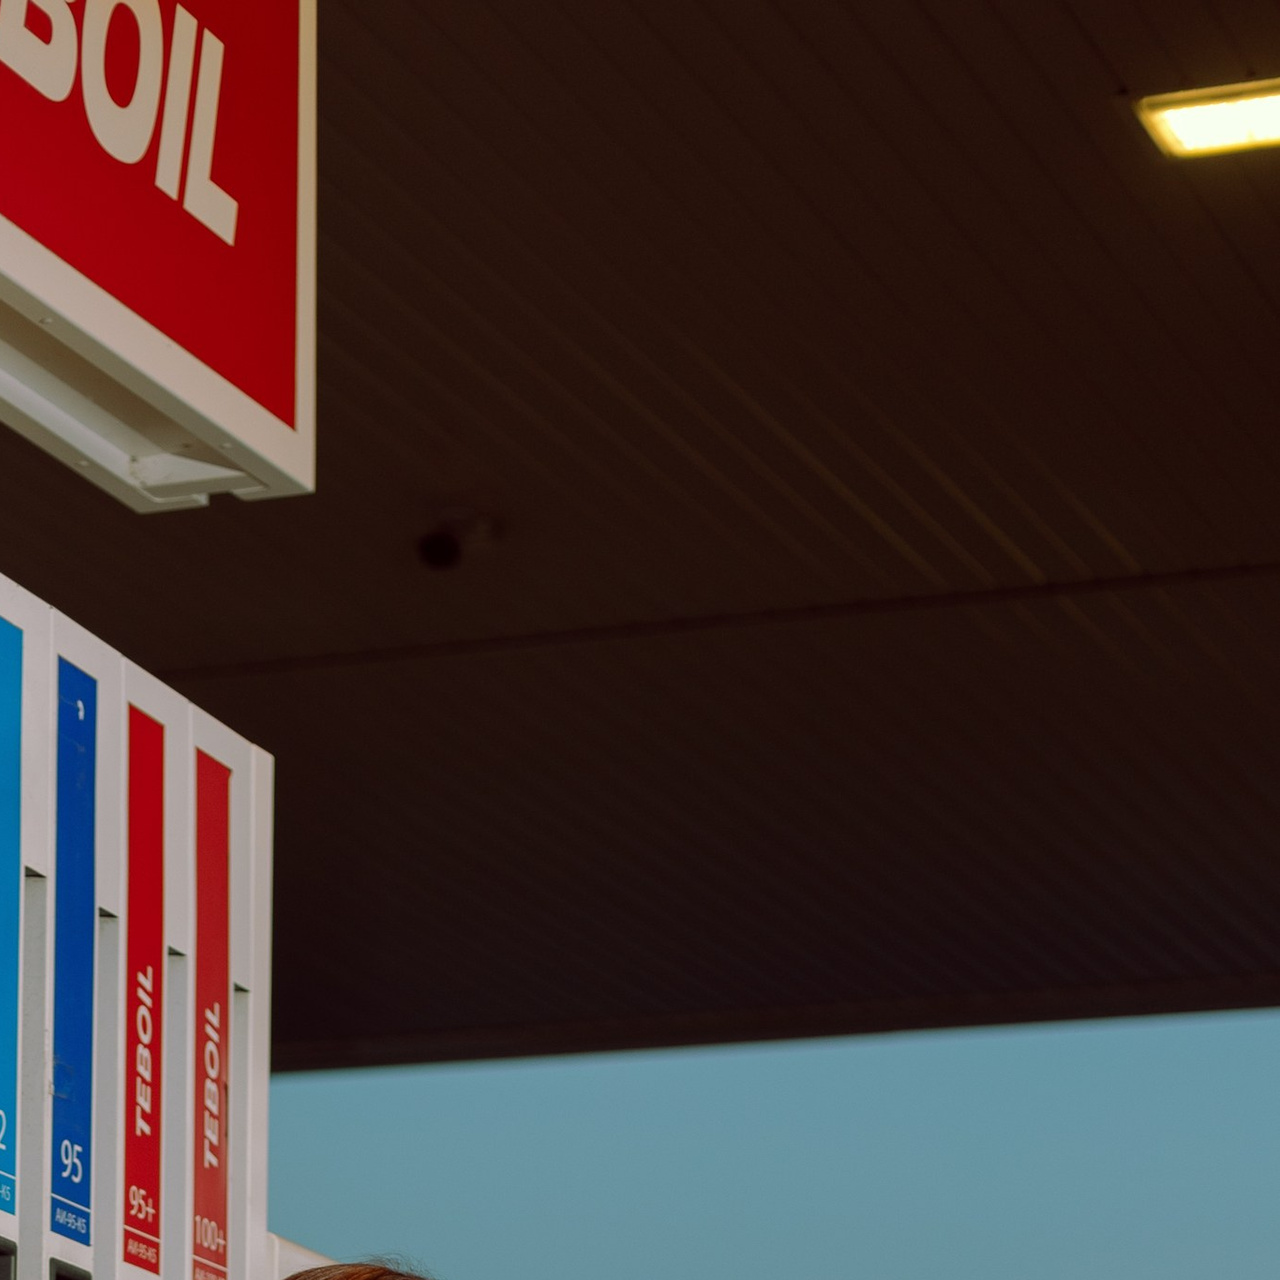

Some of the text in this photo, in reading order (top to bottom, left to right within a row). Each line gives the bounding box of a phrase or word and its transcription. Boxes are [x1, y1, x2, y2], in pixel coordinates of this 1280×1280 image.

[135, 965, 153, 1137] TEBOIL
[204, 1002, 220, 1168] TEBOIL
[61, 1139, 83, 1183] 95
[129, 1185, 156, 1223] 95+
[195, 1214, 226, 1254] 100+
